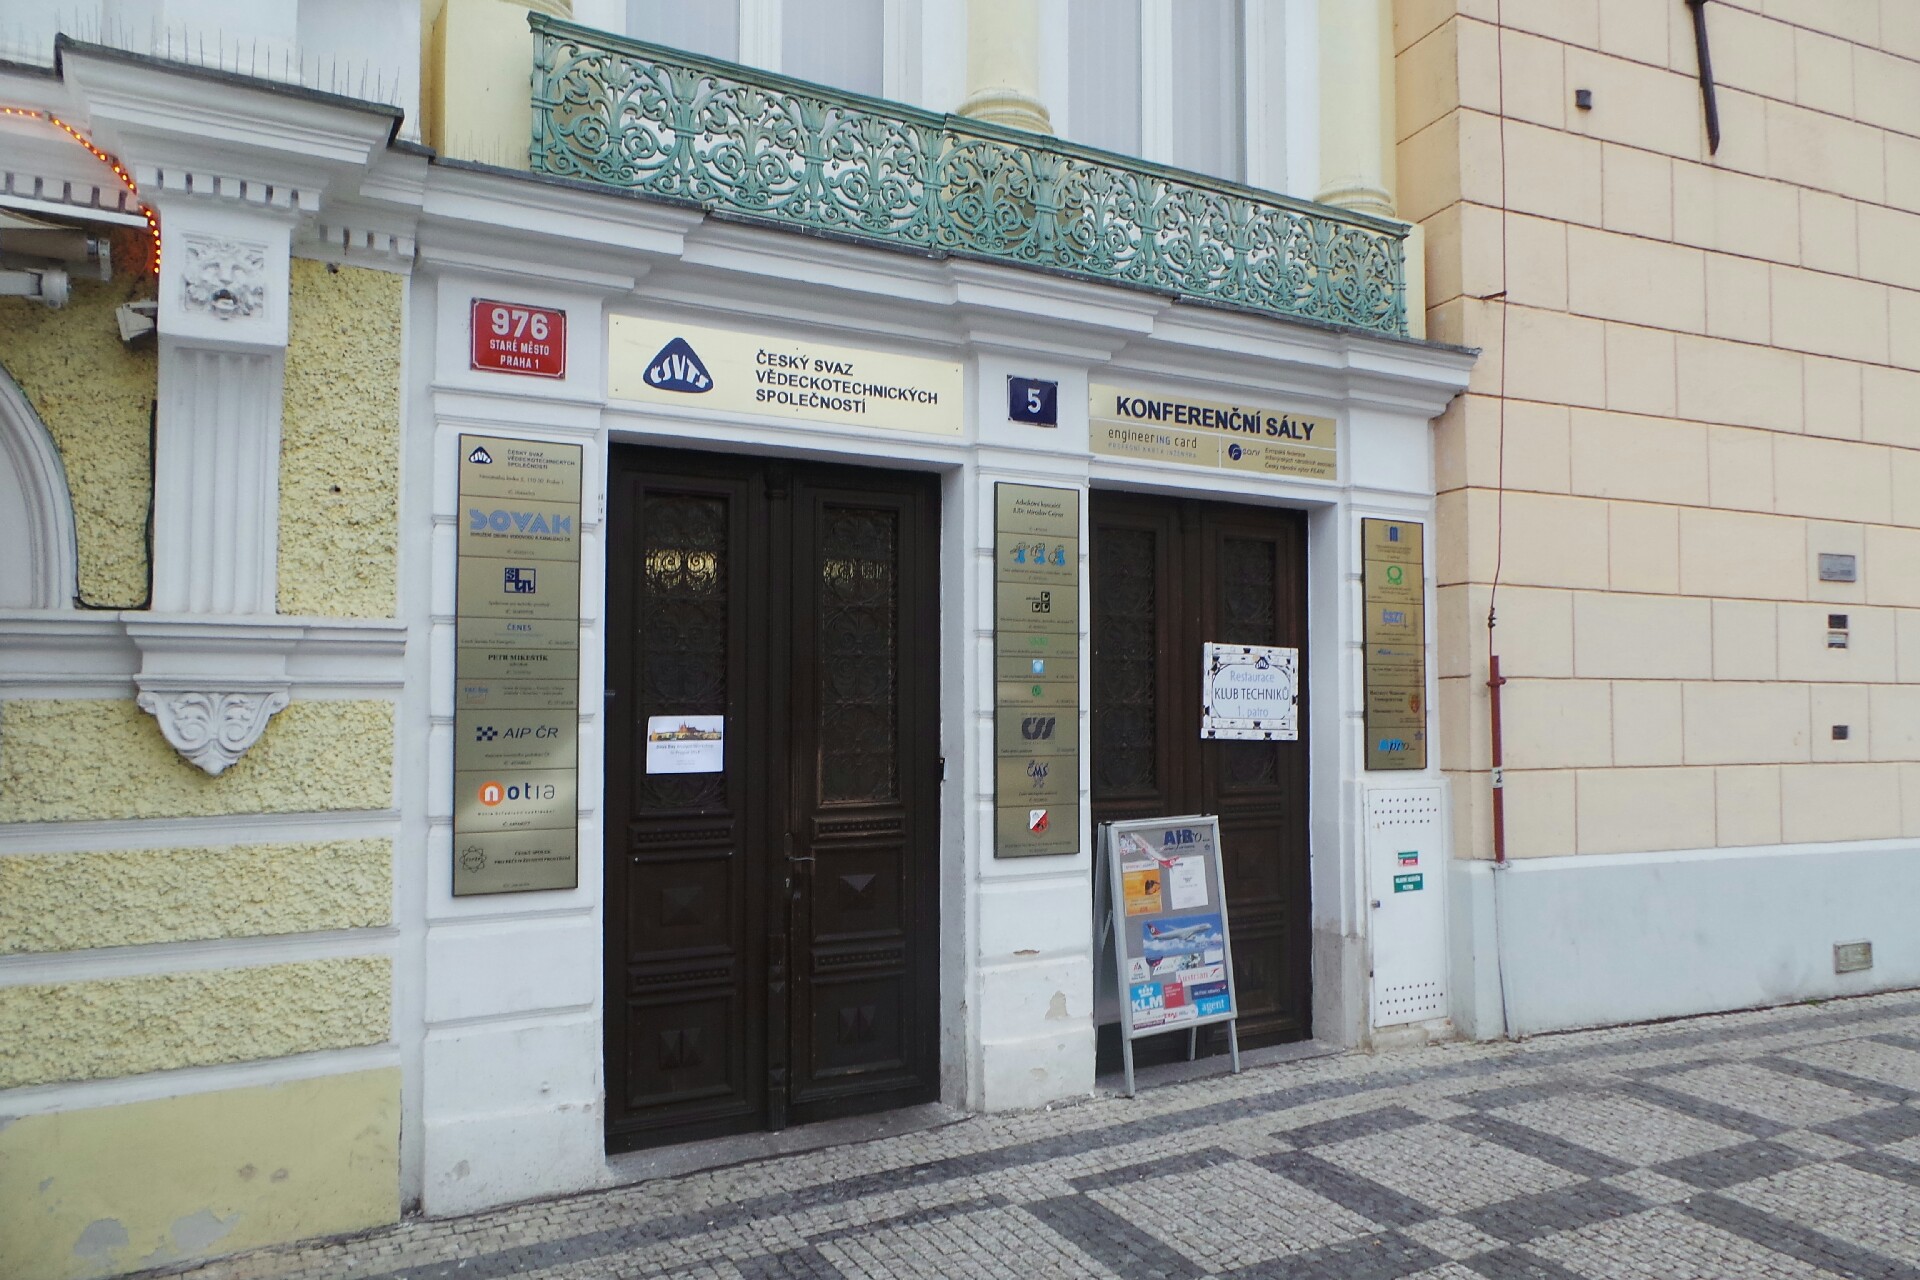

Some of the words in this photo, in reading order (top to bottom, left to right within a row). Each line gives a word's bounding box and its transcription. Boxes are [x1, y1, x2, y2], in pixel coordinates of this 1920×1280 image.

[491, 308, 549, 340] 976
[489, 339, 518, 352] STARÉ
[520, 342, 550, 356] MĚSTO
[500, 355, 532, 369] PRAHA
[534, 359, 539, 369] 1
[756, 349, 810, 370] ČESKÝ
[814, 359, 854, 376] SVAZ
[755, 369, 938, 405] VĚDECKOTECHNICKÝCH
[756, 389, 866, 413] SPOLEČNOSTÍ
[1027, 387, 1042, 414] 5
[1116, 396, 1262, 434] KONFERENČNÍ
[1265, 415, 1315, 441] SÁLY
[1108, 428, 1171, 446] engineerING
[1174, 437, 1197, 449] card
[1230, 671, 1275, 682] Restaurace
[1214, 688, 1239, 700] KLUB
[1241, 687, 1289, 701] TECHNIKŮ
[1247, 708, 1269, 718] patro
[503, 727, 532, 739] AIP
[535, 724, 559, 739] ČR
[484, 782, 555, 802] notia
[1132, 995, 1163, 1013] KLM
[1201, 998, 1224, 1015] agent
